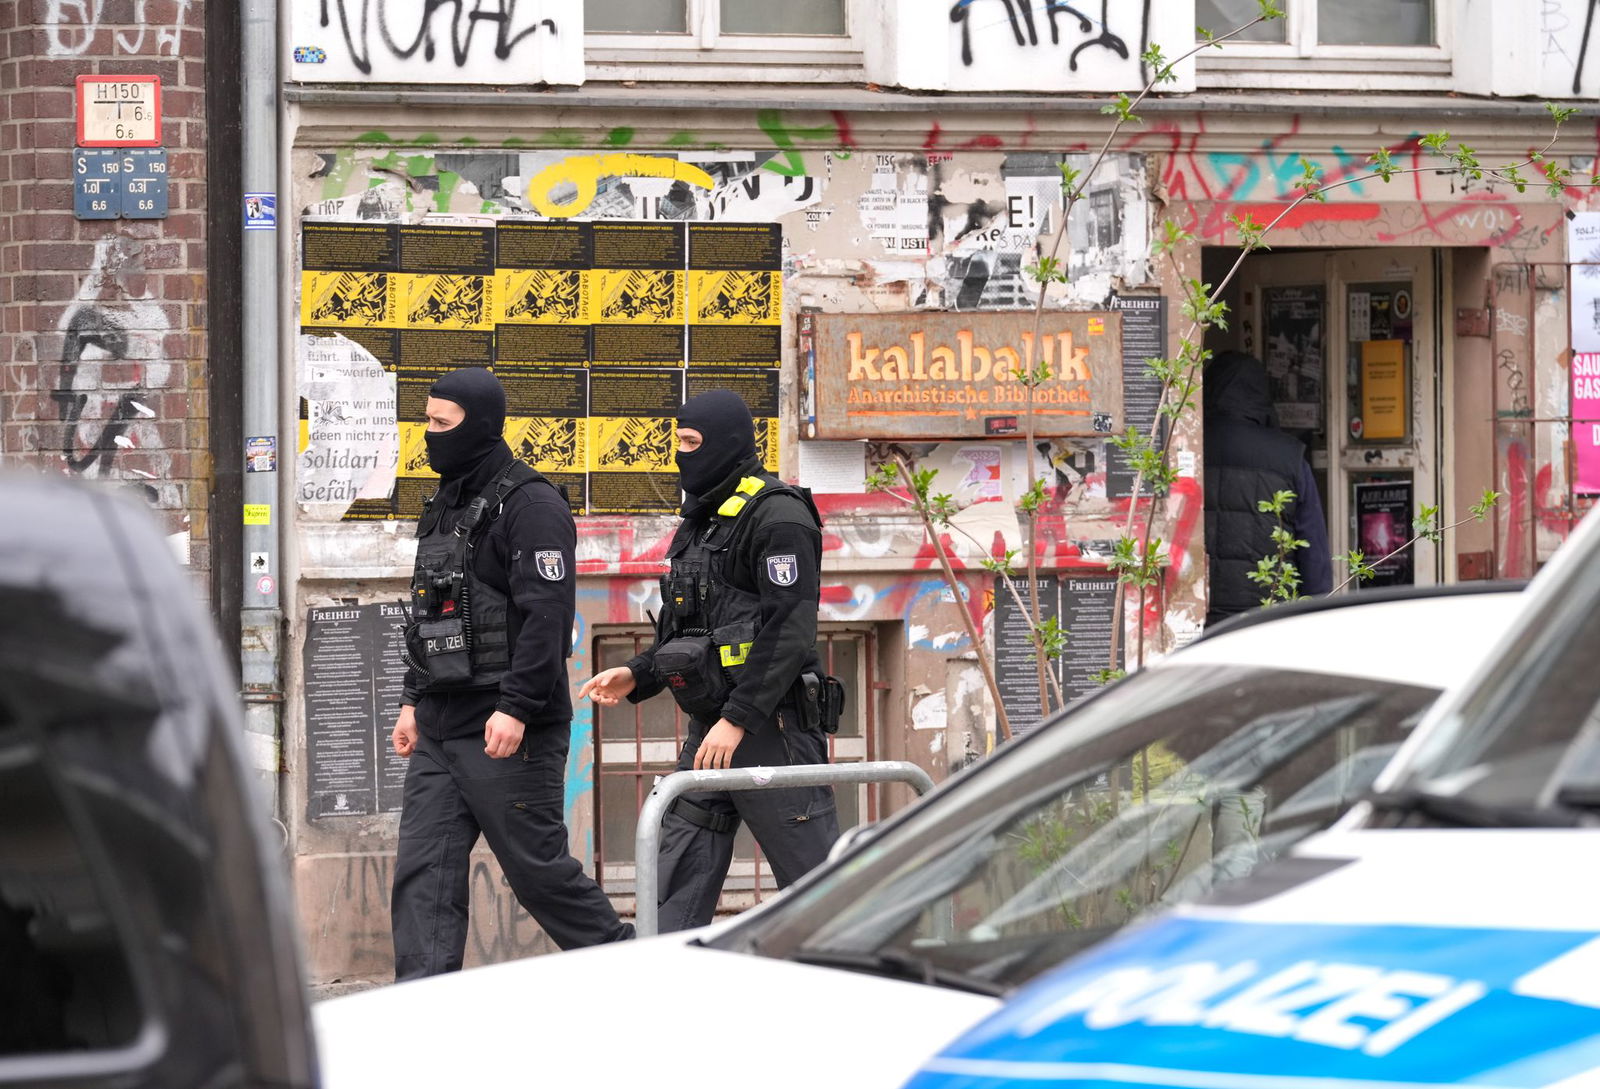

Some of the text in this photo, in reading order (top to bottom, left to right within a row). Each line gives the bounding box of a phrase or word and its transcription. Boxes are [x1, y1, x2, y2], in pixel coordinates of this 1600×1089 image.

[116, 124, 134, 139] 6.6
[78, 158, 119, 174] S 150
[124, 158, 166, 173] S 150
[92, 200, 107, 211] 6.6
[138, 200, 154, 210] 6.6
[1008, 196, 1035, 228] E!
[388, 276, 397, 324] SABOTAGE!
[485, 279, 493, 326] SABOTAGE!
[1114, 298, 1160, 309] FREIHEIT
[847, 385, 989, 404] Anarchistische
[346, 430, 375, 441] nicht
[304, 448, 379, 469] Solidari
[302, 479, 363, 502] Gefäh
[769, 556, 794, 565] POLIZEI
[1069, 580, 1116, 591] FREIHEIT
[312, 610, 361, 622] FREIHEIT
[427, 635, 464, 653] POIZEI
[1017, 960, 1488, 1057] POLIZEI
